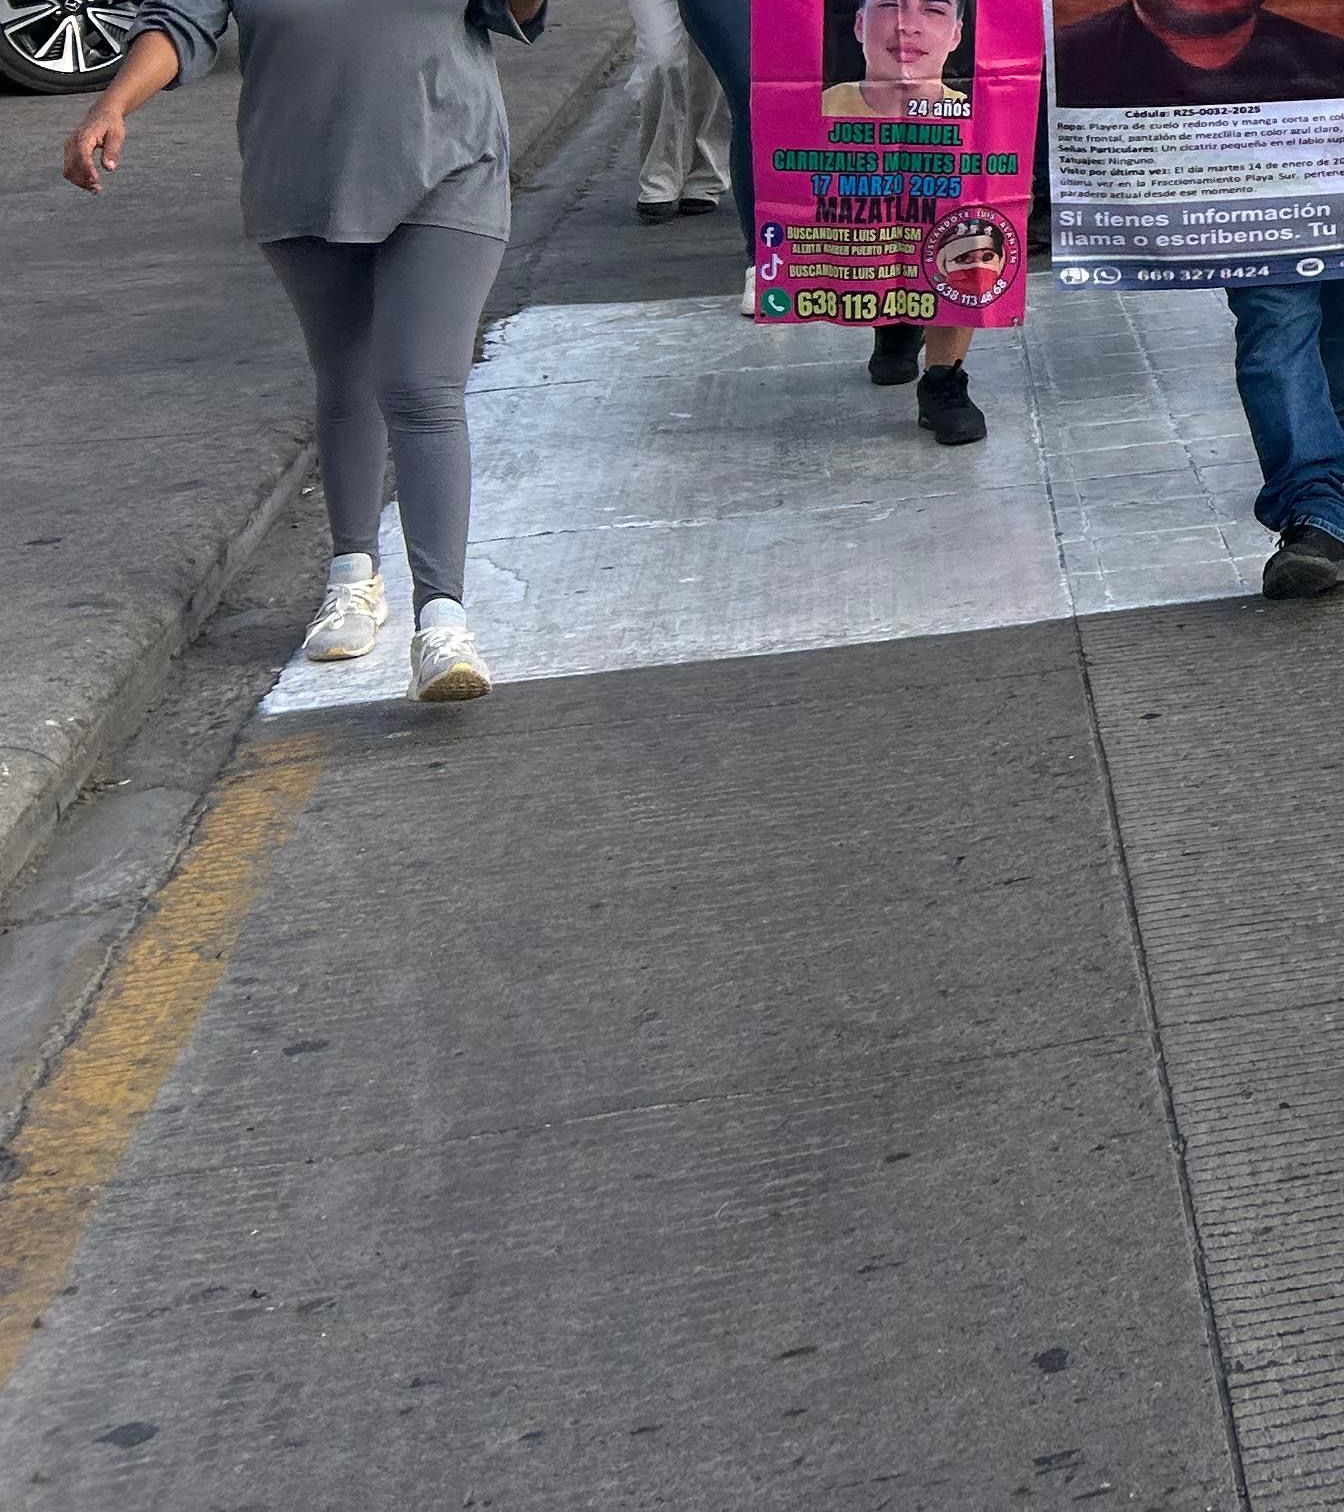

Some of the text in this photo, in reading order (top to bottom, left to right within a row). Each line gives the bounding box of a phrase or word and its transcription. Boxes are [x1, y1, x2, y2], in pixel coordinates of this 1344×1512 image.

[908, 98, 971, 118] 24 años
[828, 122, 963, 146] JOSE EMANUEL
[772, 149, 1019, 175] CARRIZALES MONTES DE OCA
[810, 174, 961, 198] 17 MARZO 2025
[1060, 210, 1082, 227] Si
[1094, 210, 1170, 227] tienes
[1182, 202, 1331, 226] información
[1060, 231, 1125, 247] llama
[1133, 234, 1149, 247] o
[1308, 221, 1337, 238] Tu
[797, 289, 838, 318] 638
[842, 290, 878, 320] 113
